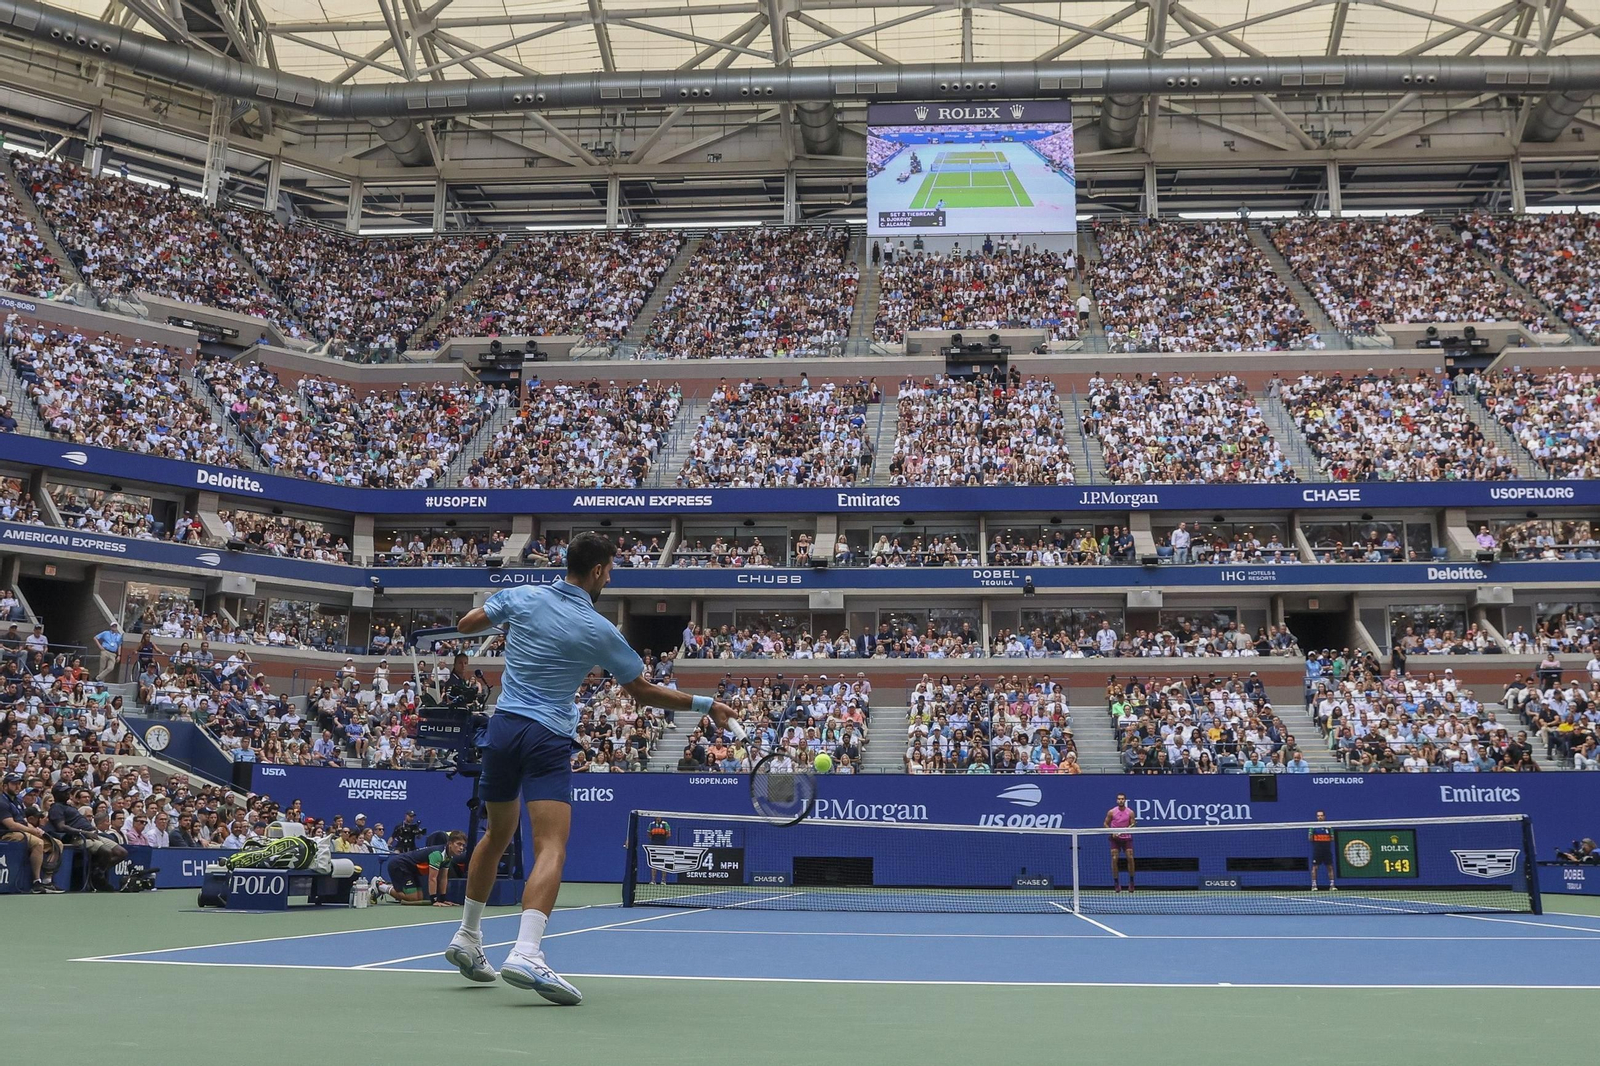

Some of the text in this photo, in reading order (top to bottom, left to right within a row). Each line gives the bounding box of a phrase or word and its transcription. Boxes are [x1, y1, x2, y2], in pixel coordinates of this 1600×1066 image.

[938, 108, 1000, 120] ROLEX
[196, 469, 264, 493] Deloitte.
[837, 492, 901, 507] Emirates
[1302, 488, 1361, 502] CHASE
[1490, 487, 1574, 500] USOPEN.ORG
[425, 496, 487, 507] #USOPEN
[573, 495, 713, 507] AMERICAN EXPRESS
[1079, 492, 1159, 508] J.P.Morgan
[3, 528, 127, 553] AMERICAN EXPRESS
[489, 574, 567, 583] CADILLA
[737, 574, 802, 584] CHUBB
[972, 570, 1020, 579] DOBEL
[1221, 571, 1245, 581] IHG
[1427, 567, 1488, 580] Deloitte.
[419, 724, 461, 733] CHUBB
[262, 767, 287, 777] USTA
[339, 778, 407, 790] AMERICAN
[1312, 777, 1364, 785] USOPEN.ORG
[347, 789, 407, 800] EXPRESS
[573, 786, 614, 802] rates
[1440, 785, 1521, 802] Emirates
[794, 798, 929, 823] J.P.Morgan
[693, 829, 733, 848] IBM
[720, 861, 739, 870] MPH
[1384, 859, 1410, 873] 1:43
[1563, 869, 1585, 880] DOBEL
[231, 875, 285, 895] POLO
